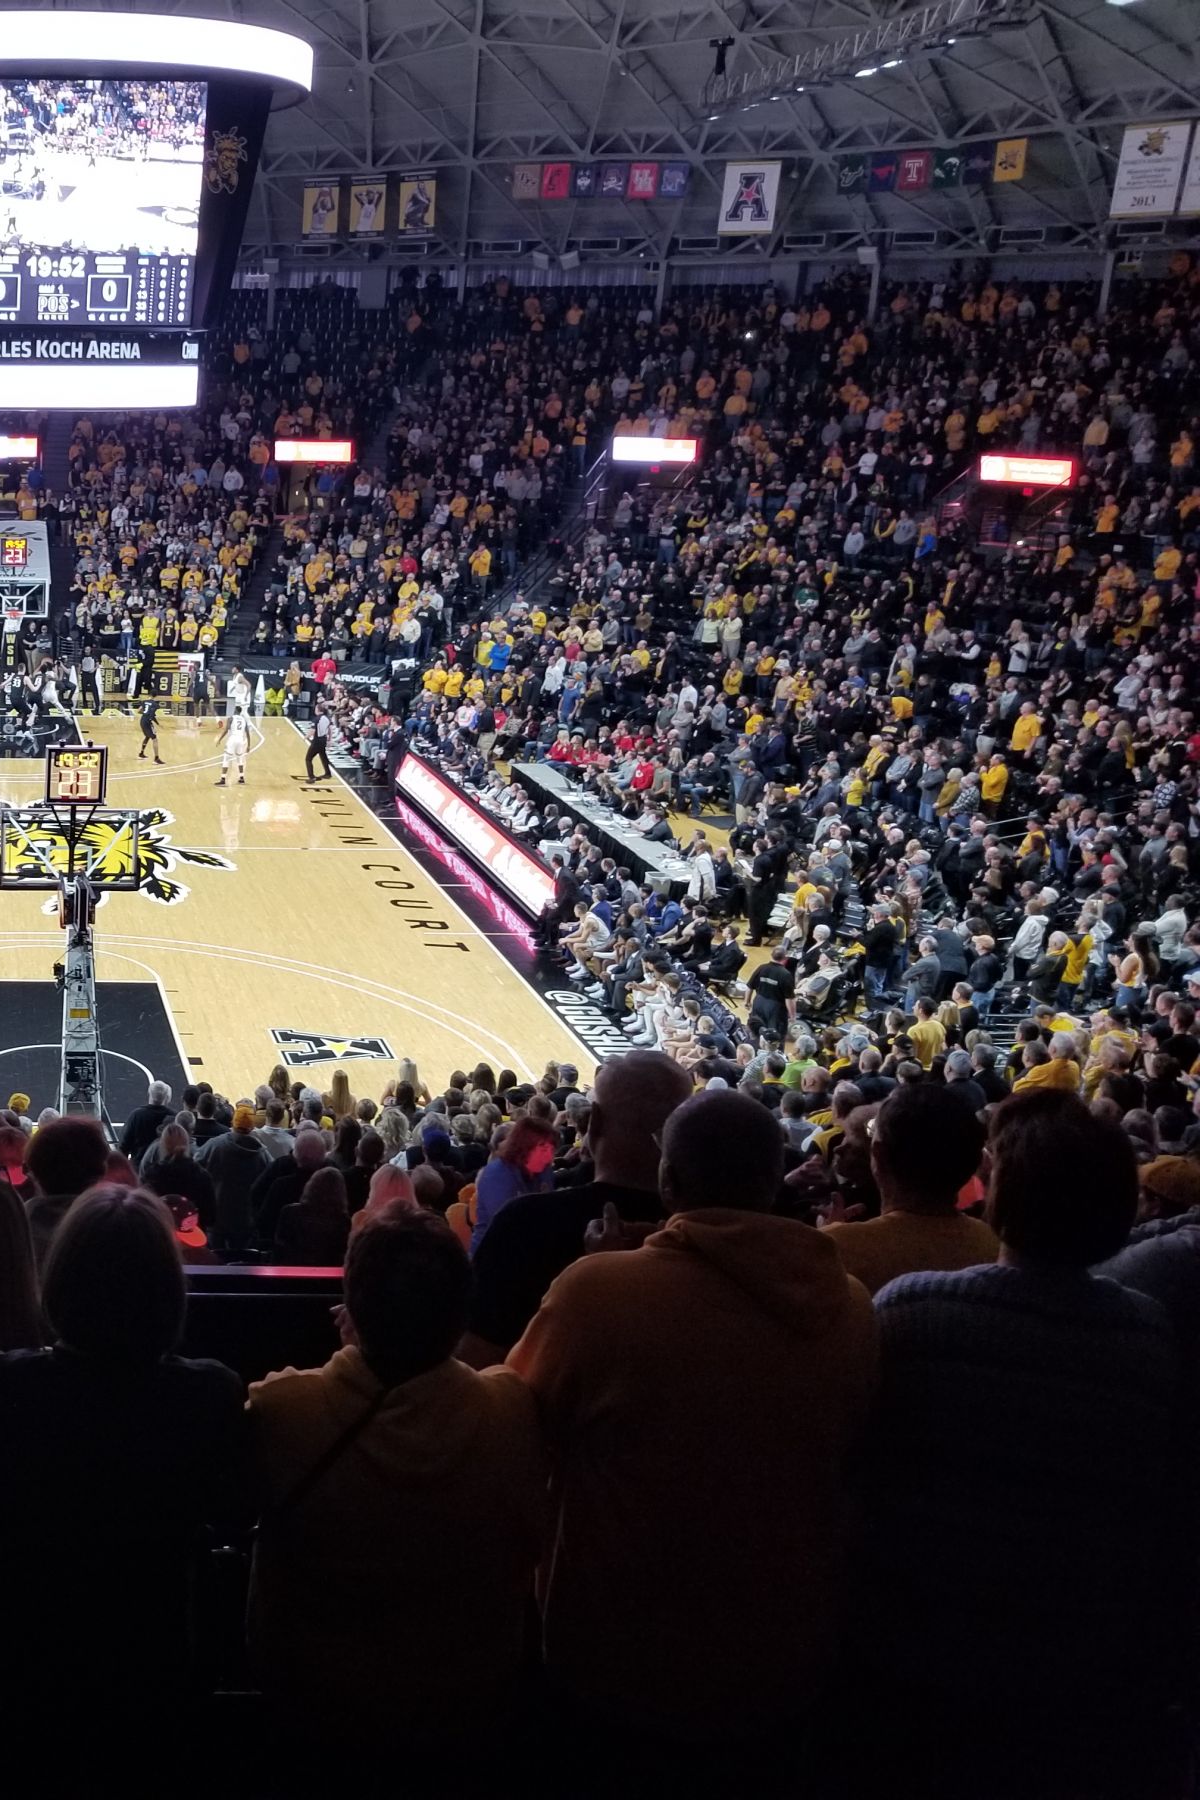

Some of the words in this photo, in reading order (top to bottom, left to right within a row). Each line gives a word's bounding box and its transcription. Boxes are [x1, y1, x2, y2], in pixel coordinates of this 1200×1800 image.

[26, 256, 86, 277] 19:52
[102, 279, 117, 302] 0
[38, 296, 69, 312] POS
[36, 339, 83, 358] KOCH
[86, 340, 141, 359] ARENA
[6, 549, 22, 563] 23
[6, 634, 16, 665] WSU
[59, 753, 99, 768] 19:52
[58, 770, 92, 796] 23
[290, 775, 378, 845] DEVLIN
[361, 864, 470, 952] COURT
